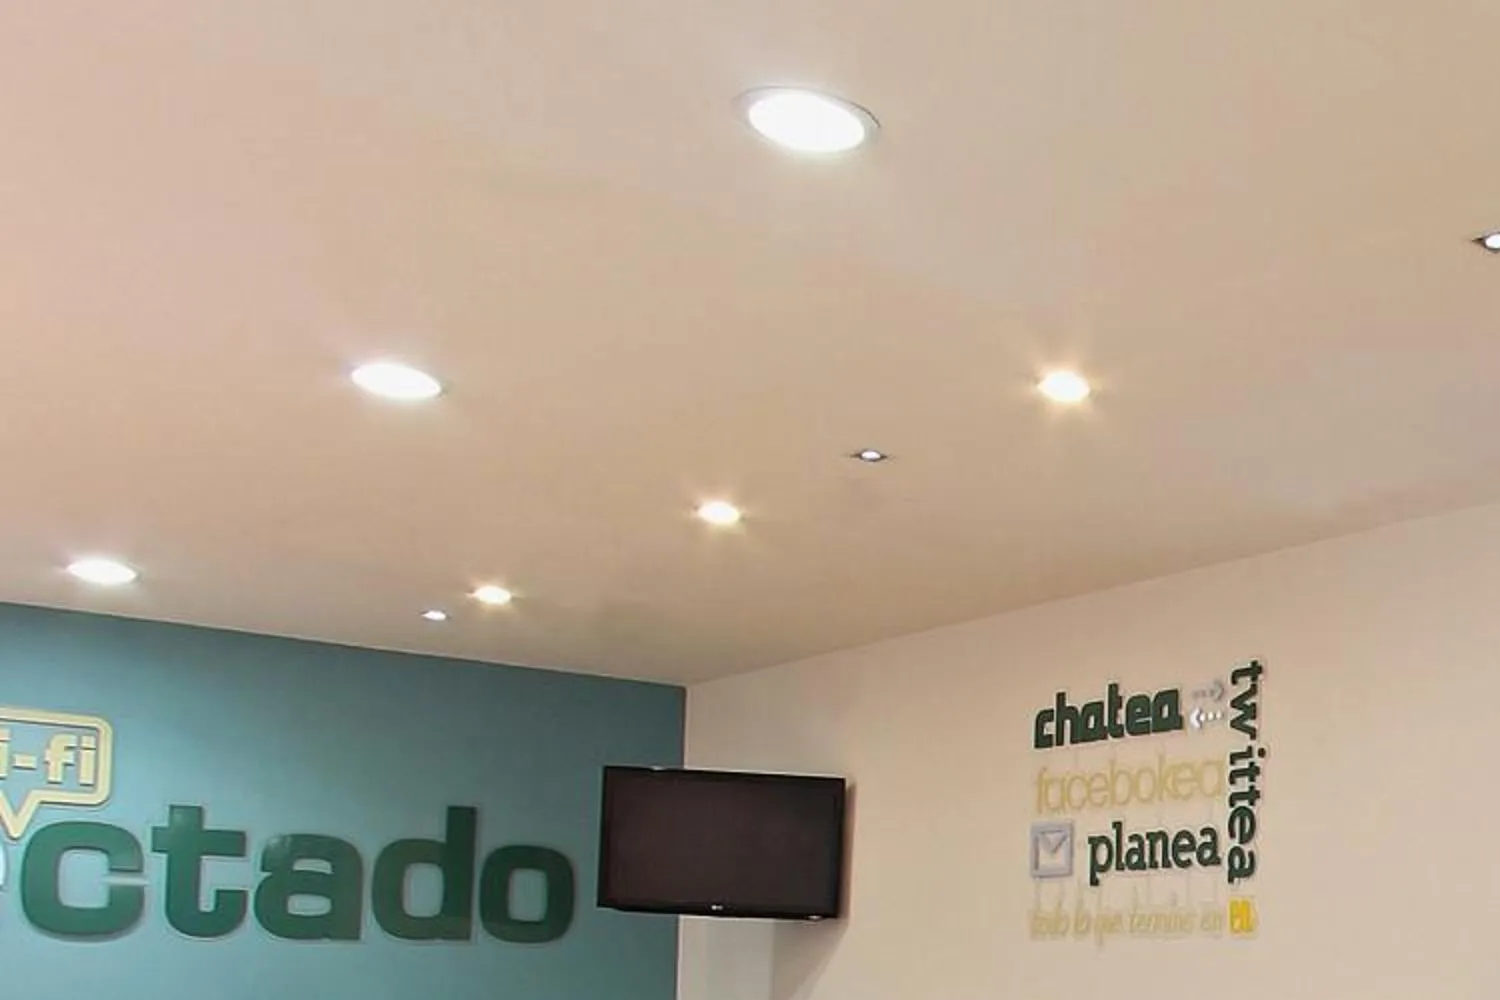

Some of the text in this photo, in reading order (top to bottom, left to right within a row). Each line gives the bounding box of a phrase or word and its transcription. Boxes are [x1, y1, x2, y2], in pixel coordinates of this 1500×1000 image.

[1034, 683, 1183, 748] chatea
[1227, 660, 1266, 884] twittea
[1088, 820, 1222, 886] planea
